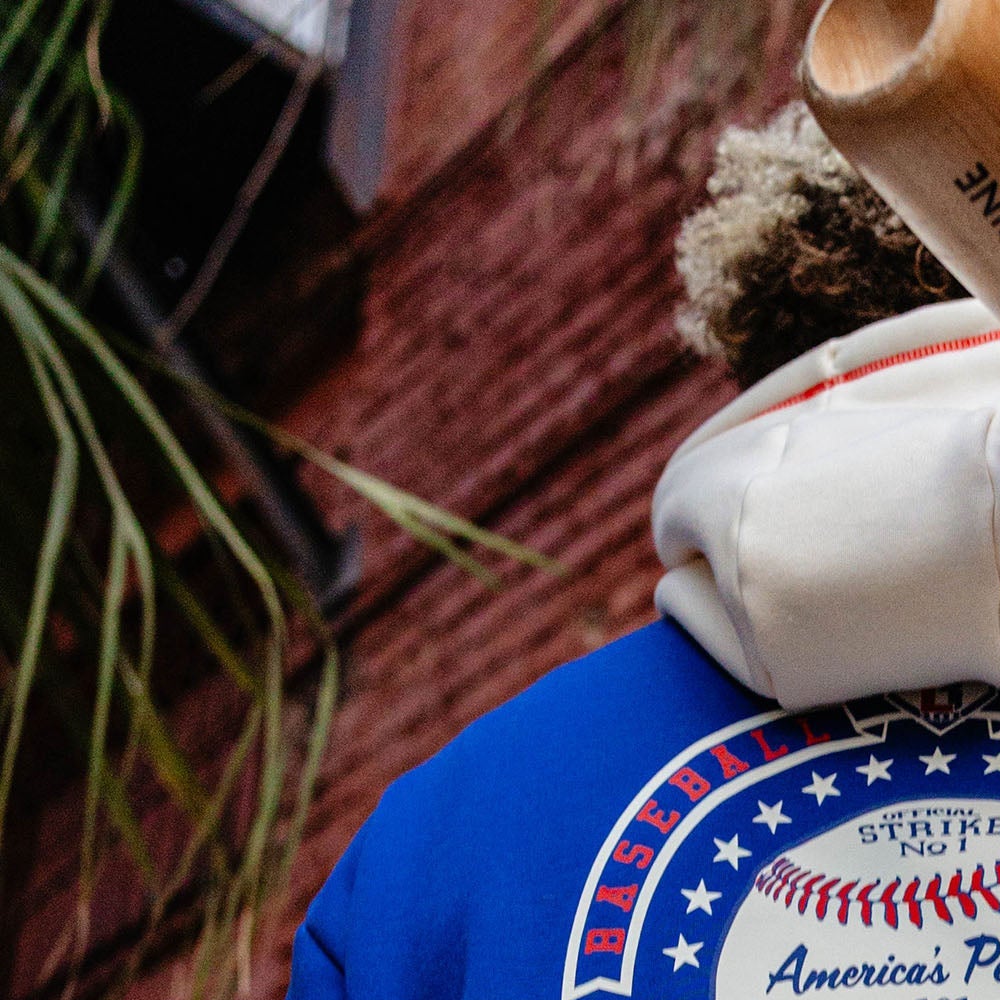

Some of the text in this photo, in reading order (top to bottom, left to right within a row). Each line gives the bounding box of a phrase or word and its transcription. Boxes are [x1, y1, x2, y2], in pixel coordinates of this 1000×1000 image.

[584, 717, 831, 956] BASEBALL
[958, 837, 968, 853] 1
[765, 943, 950, 995] America's
